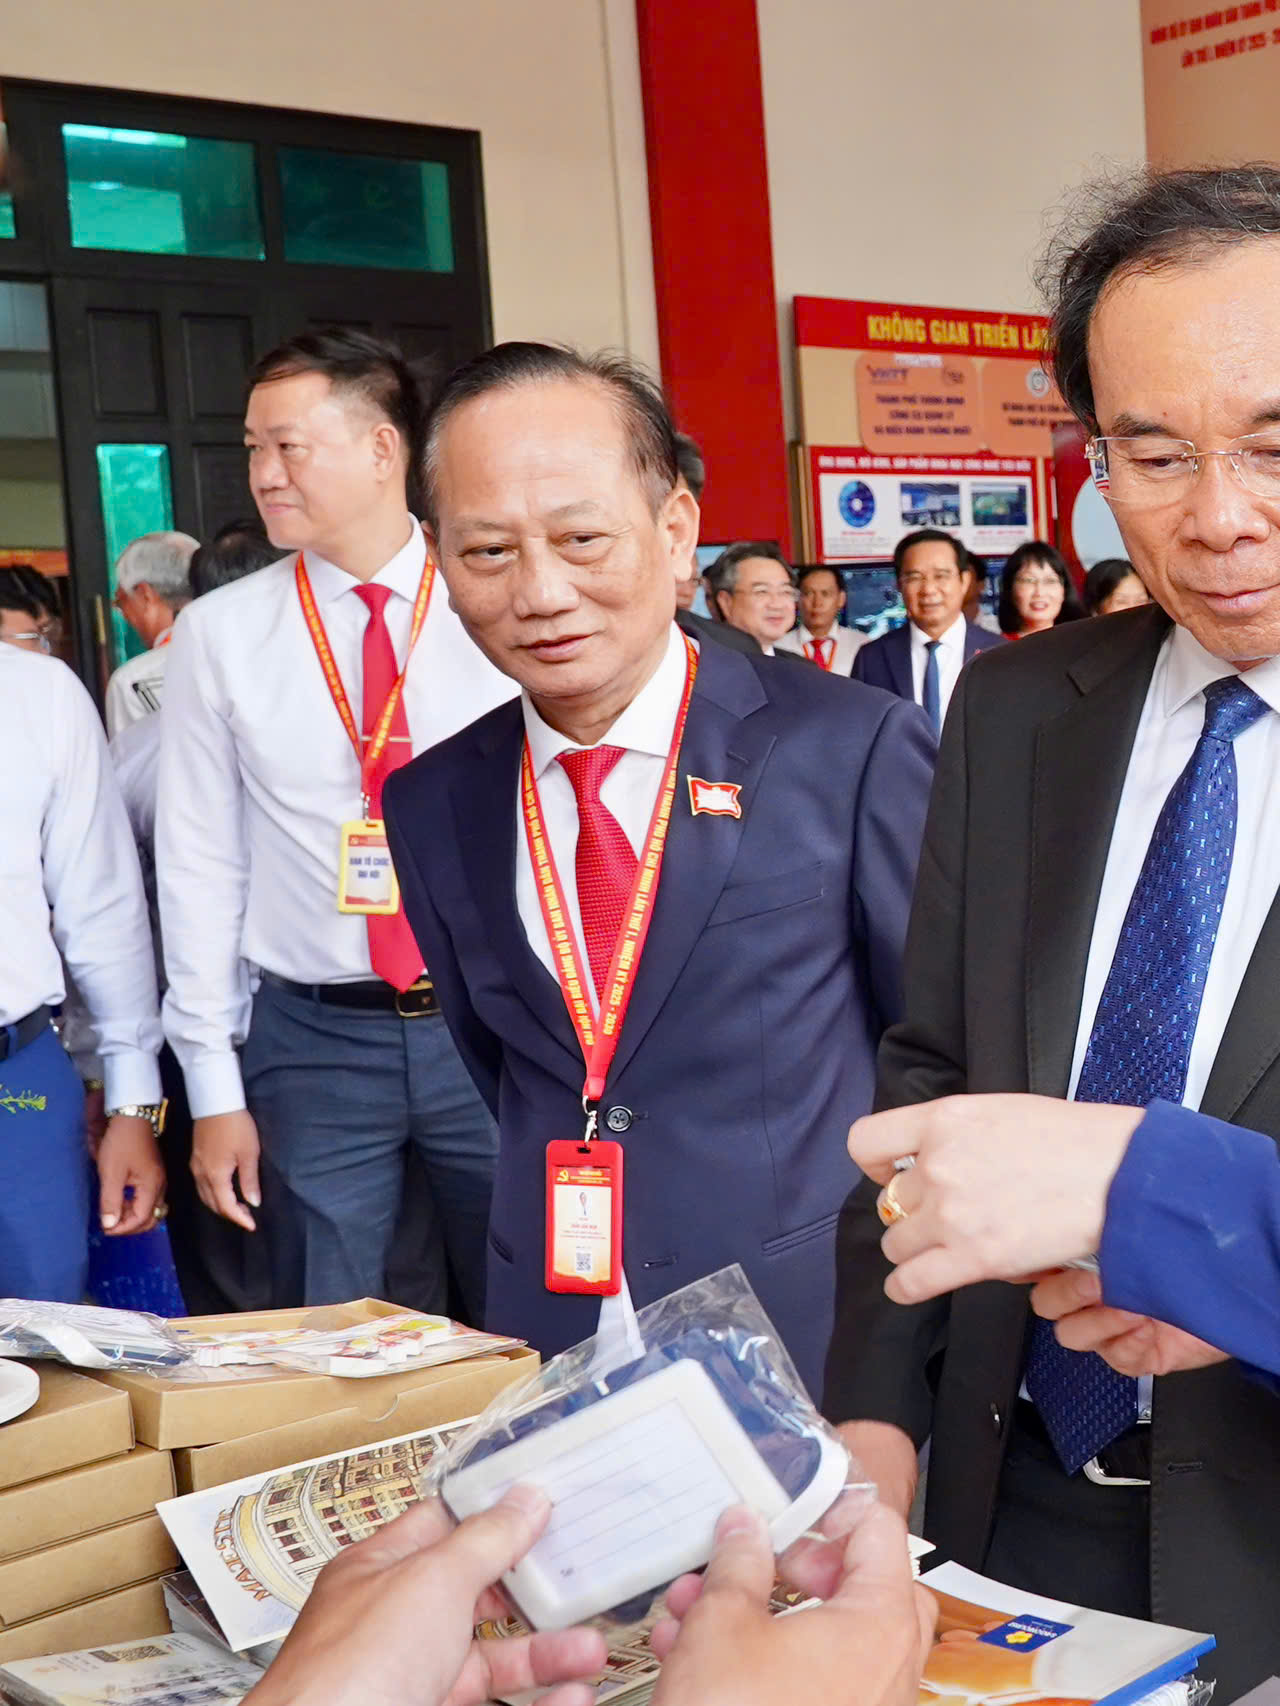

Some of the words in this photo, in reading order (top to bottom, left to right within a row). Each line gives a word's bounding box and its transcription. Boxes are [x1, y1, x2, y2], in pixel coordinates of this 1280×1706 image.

[867, 311, 926, 344] KHÔNG
[929, 319, 969, 346] GIAN
[972, 314, 1020, 349] TRIỂN
[610, 983, 624, 1006] 2025
[603, 1012, 617, 1035] 2030
